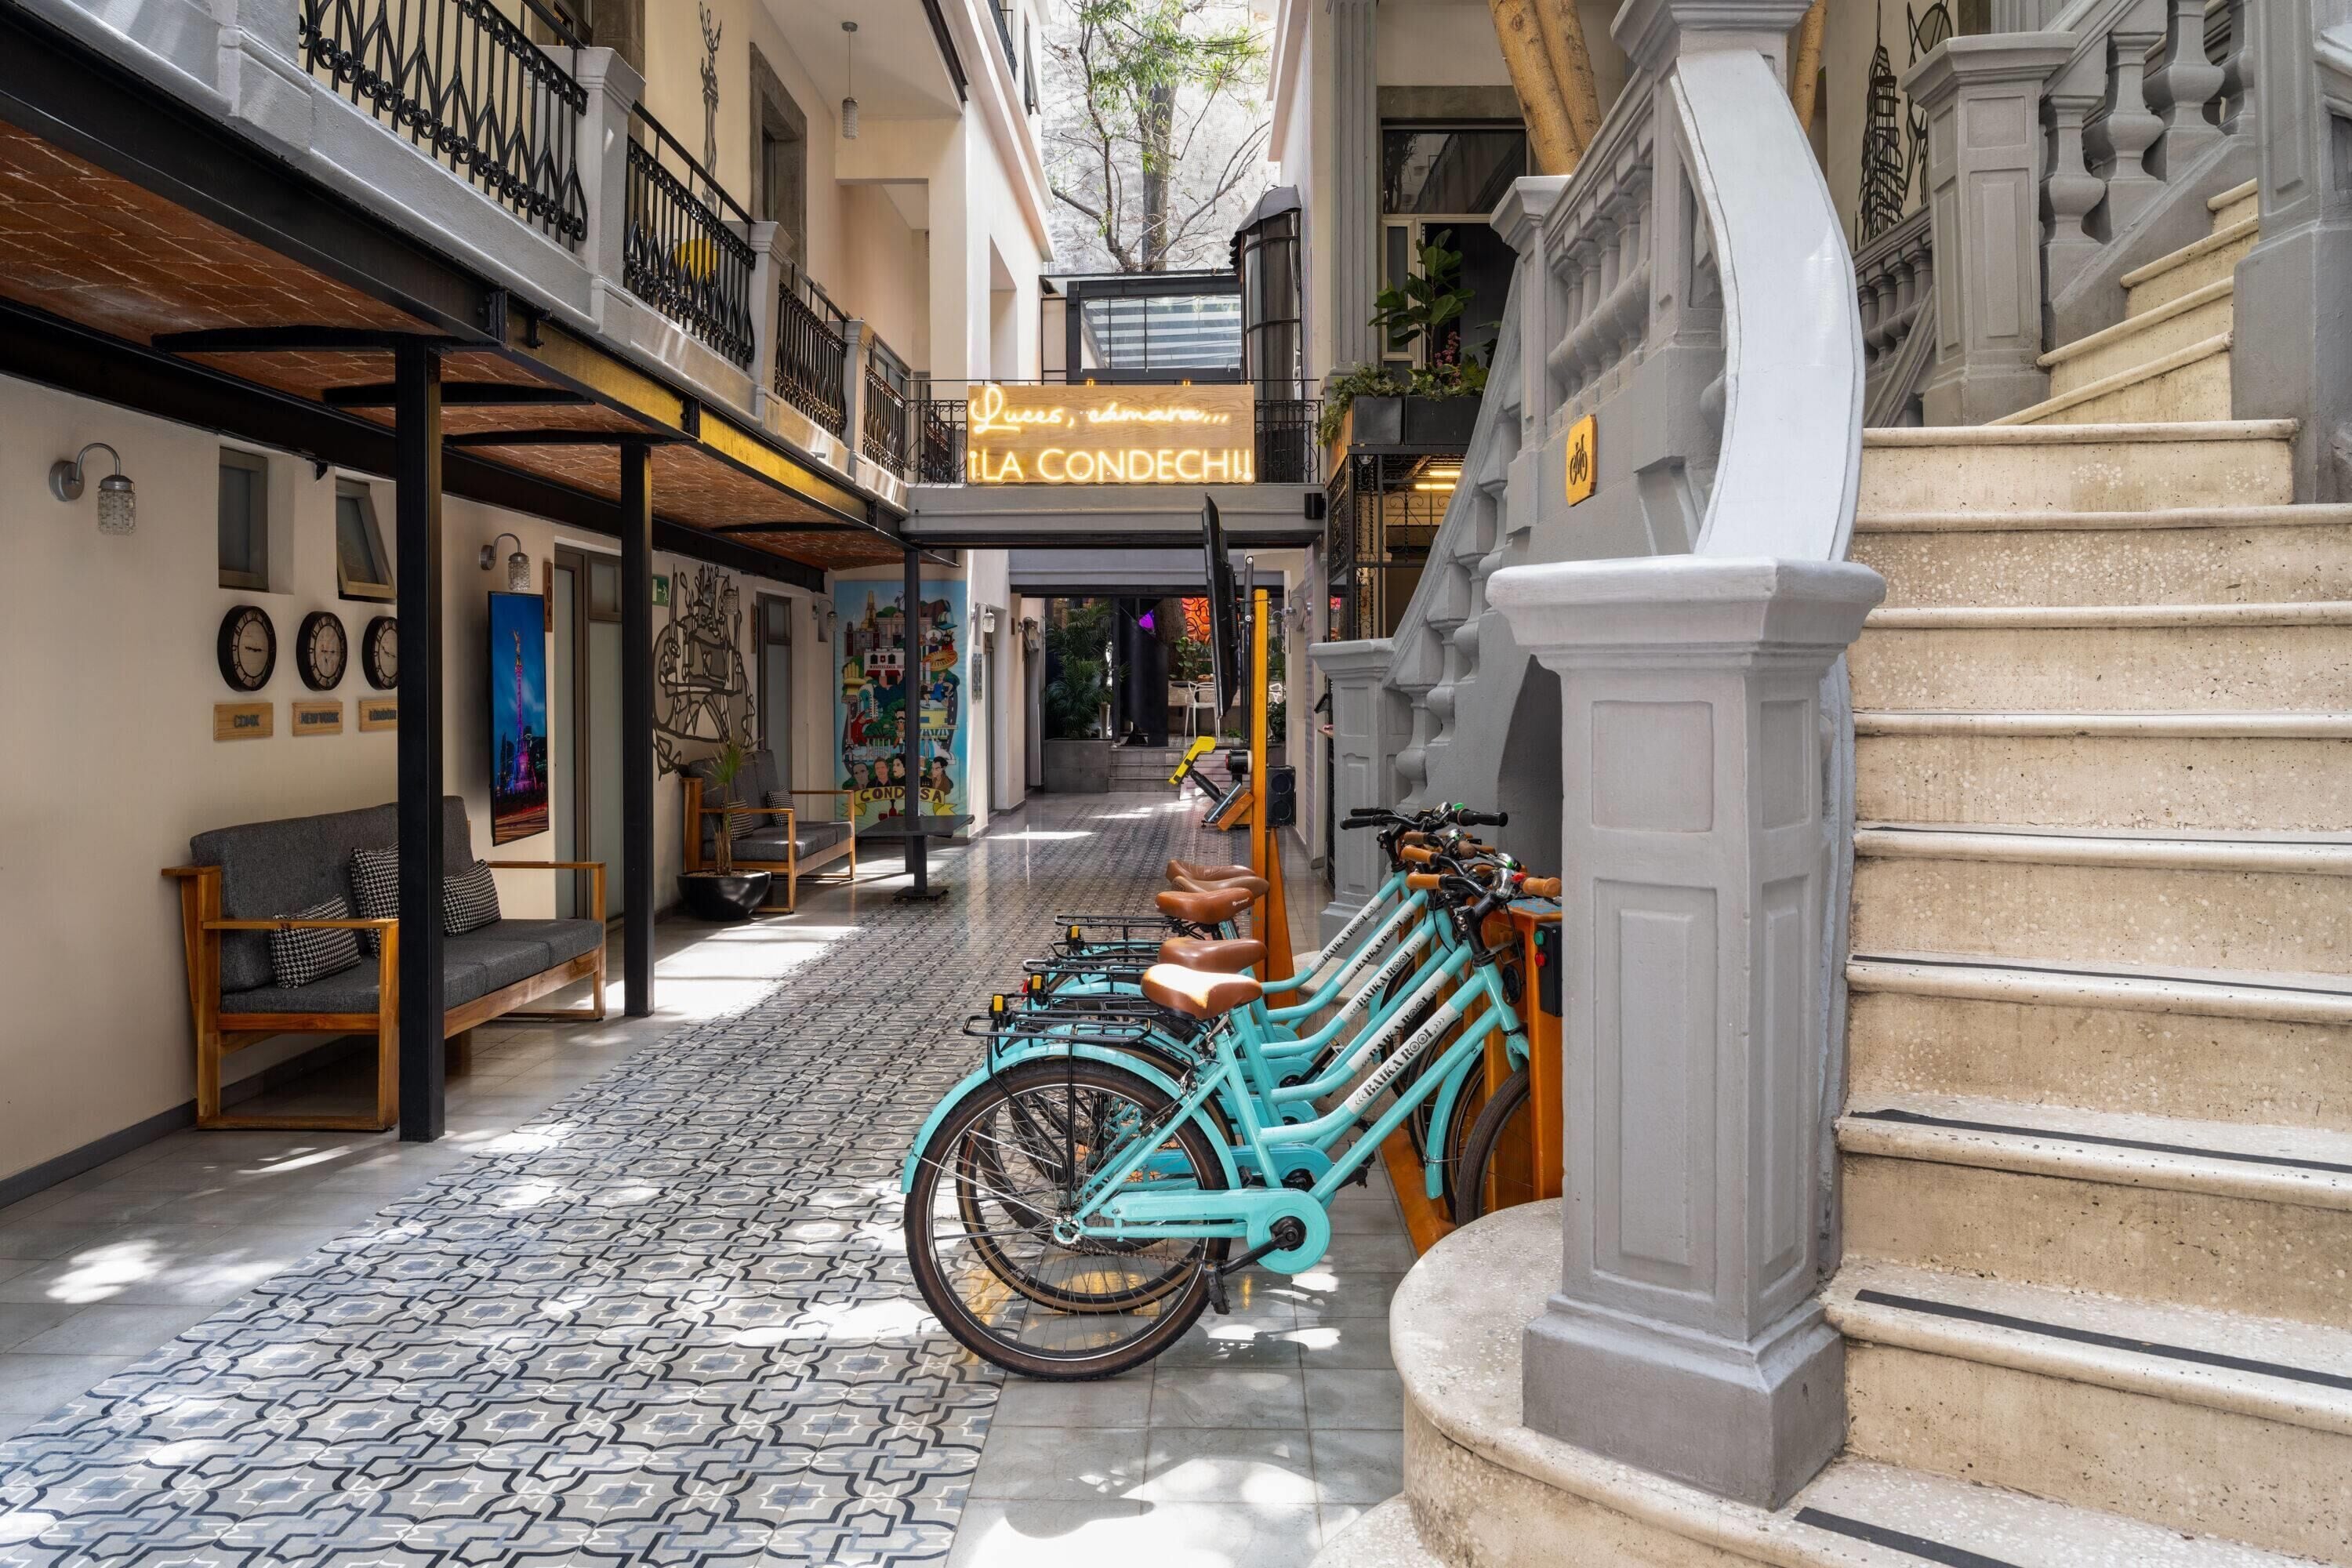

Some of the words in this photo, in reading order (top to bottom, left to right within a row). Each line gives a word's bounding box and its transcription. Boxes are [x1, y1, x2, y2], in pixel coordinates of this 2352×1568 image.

[971, 384, 1074, 434] Luces,
[969, 449, 1024, 481] ¡LA
[1036, 448, 1254, 482] CONDECHI!
[859, 786, 943, 804] CONDSA
[1356, 976, 1388, 1007] BAIKA
[1363, 1059, 1404, 1097] BAIKA
